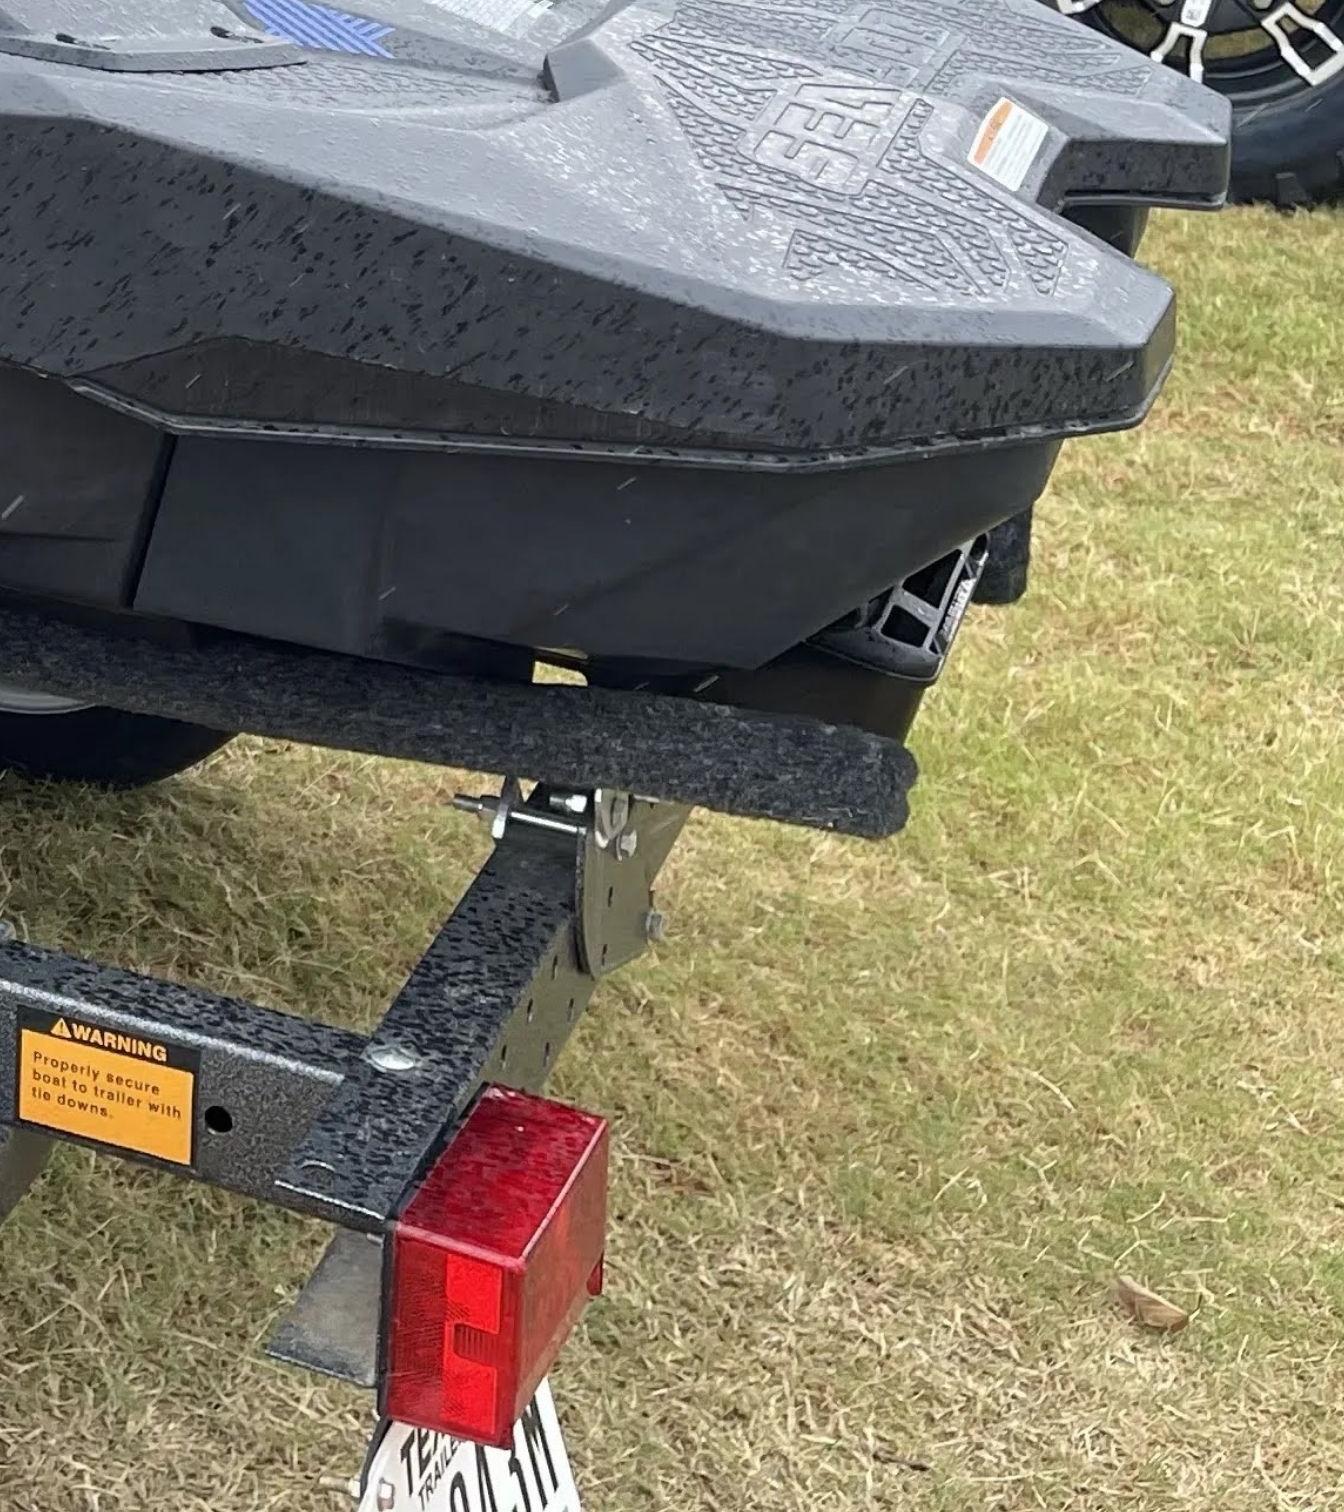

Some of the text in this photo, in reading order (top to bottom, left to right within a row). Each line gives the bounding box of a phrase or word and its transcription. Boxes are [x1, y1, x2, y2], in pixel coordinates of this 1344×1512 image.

[71, 1023, 168, 1062] WARNING
[31, 1086, 52, 1102] tie
[32, 1050, 161, 1096] Properly secure
[32, 1069, 182, 1121] boat to trailer with
